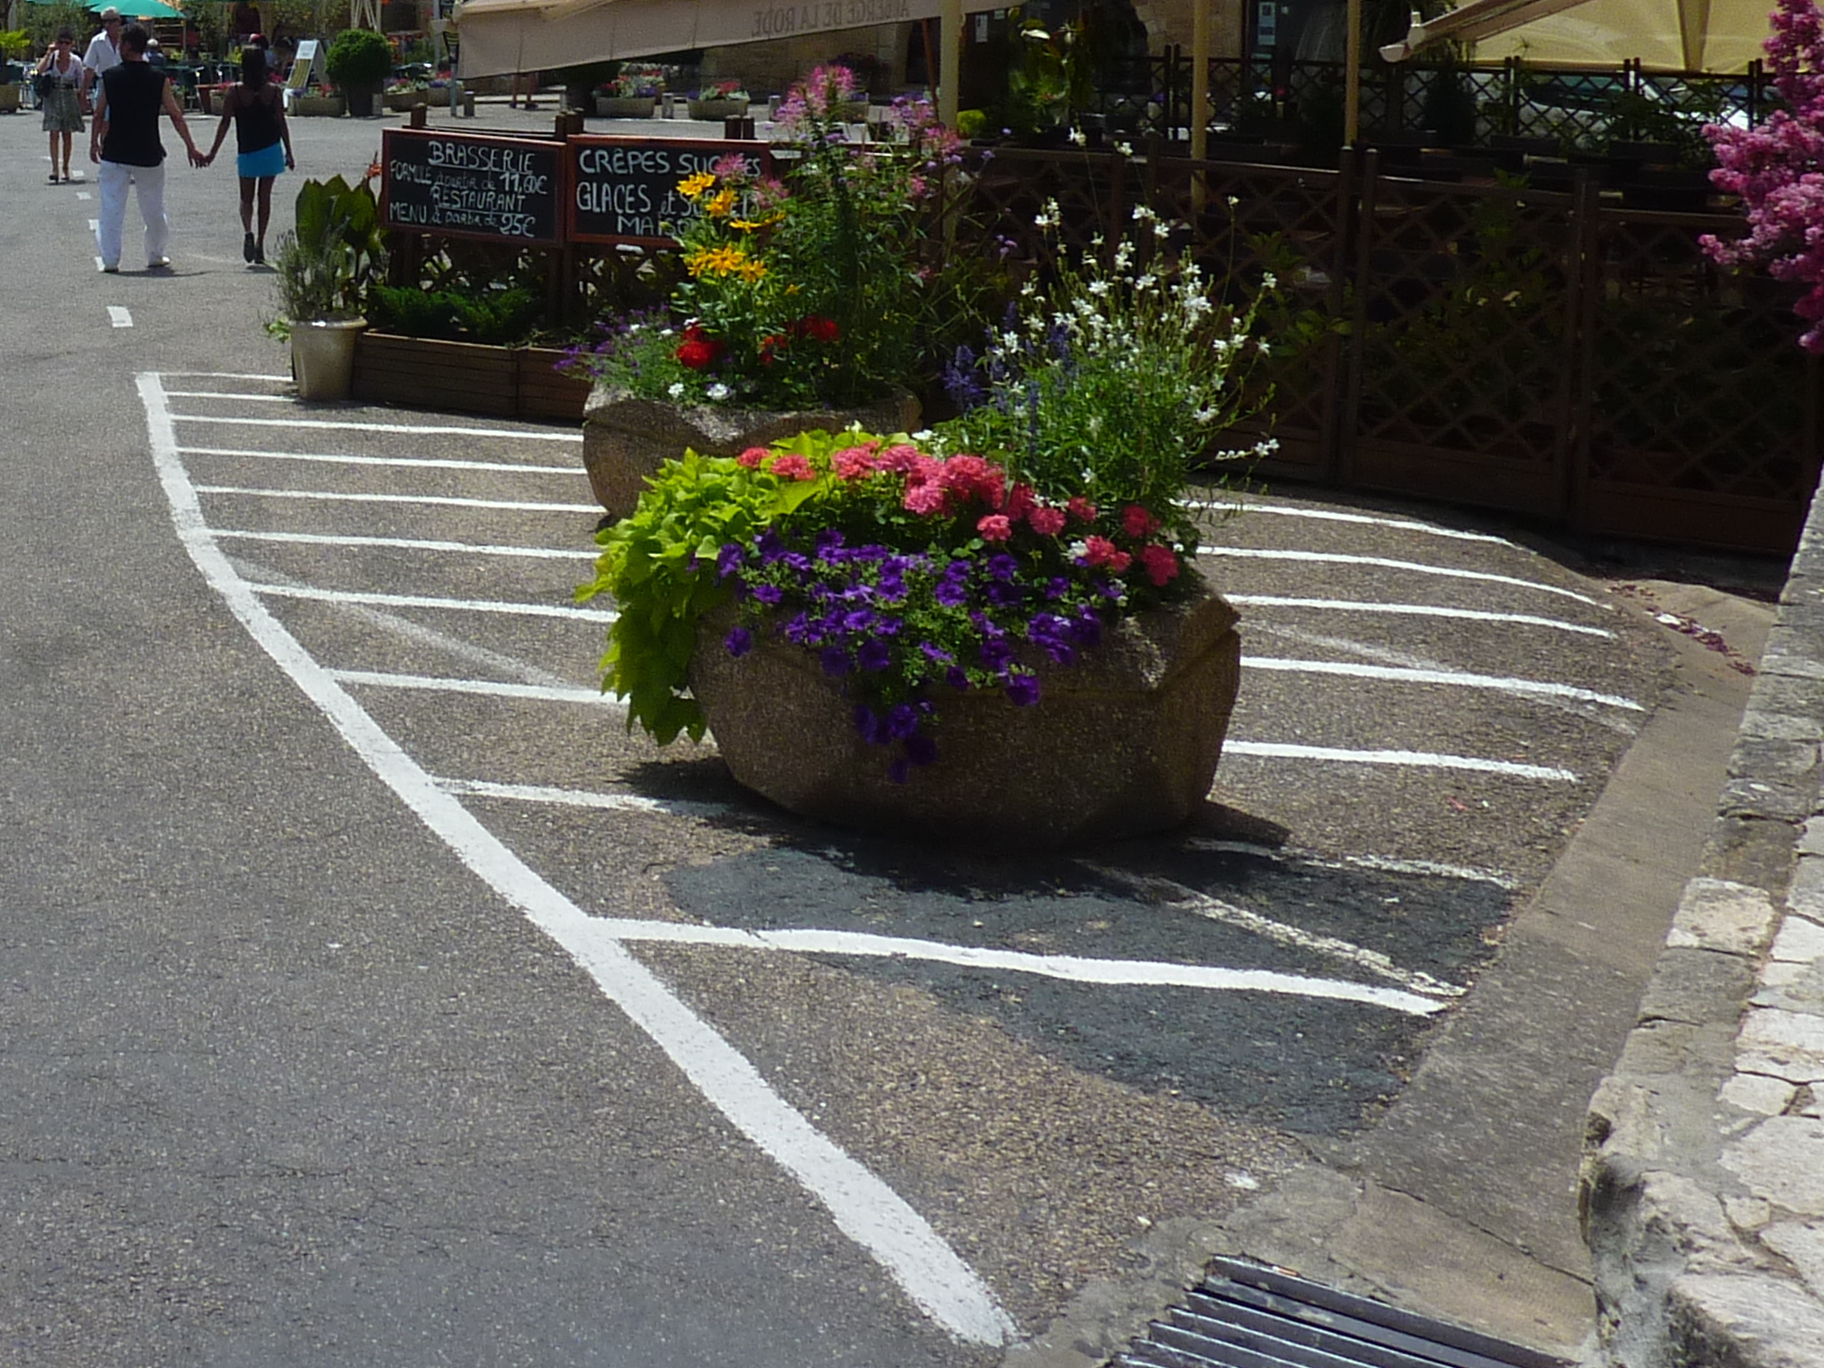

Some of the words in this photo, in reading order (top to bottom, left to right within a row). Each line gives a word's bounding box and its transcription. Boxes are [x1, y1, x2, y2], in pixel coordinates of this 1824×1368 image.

[578, 148, 671, 175] CRÊPES
[430, 185, 526, 212] RESTAURANT
[576, 181, 652, 214] GLACES
[389, 202, 427, 224] MENU
[499, 214, 536, 237] 25€
